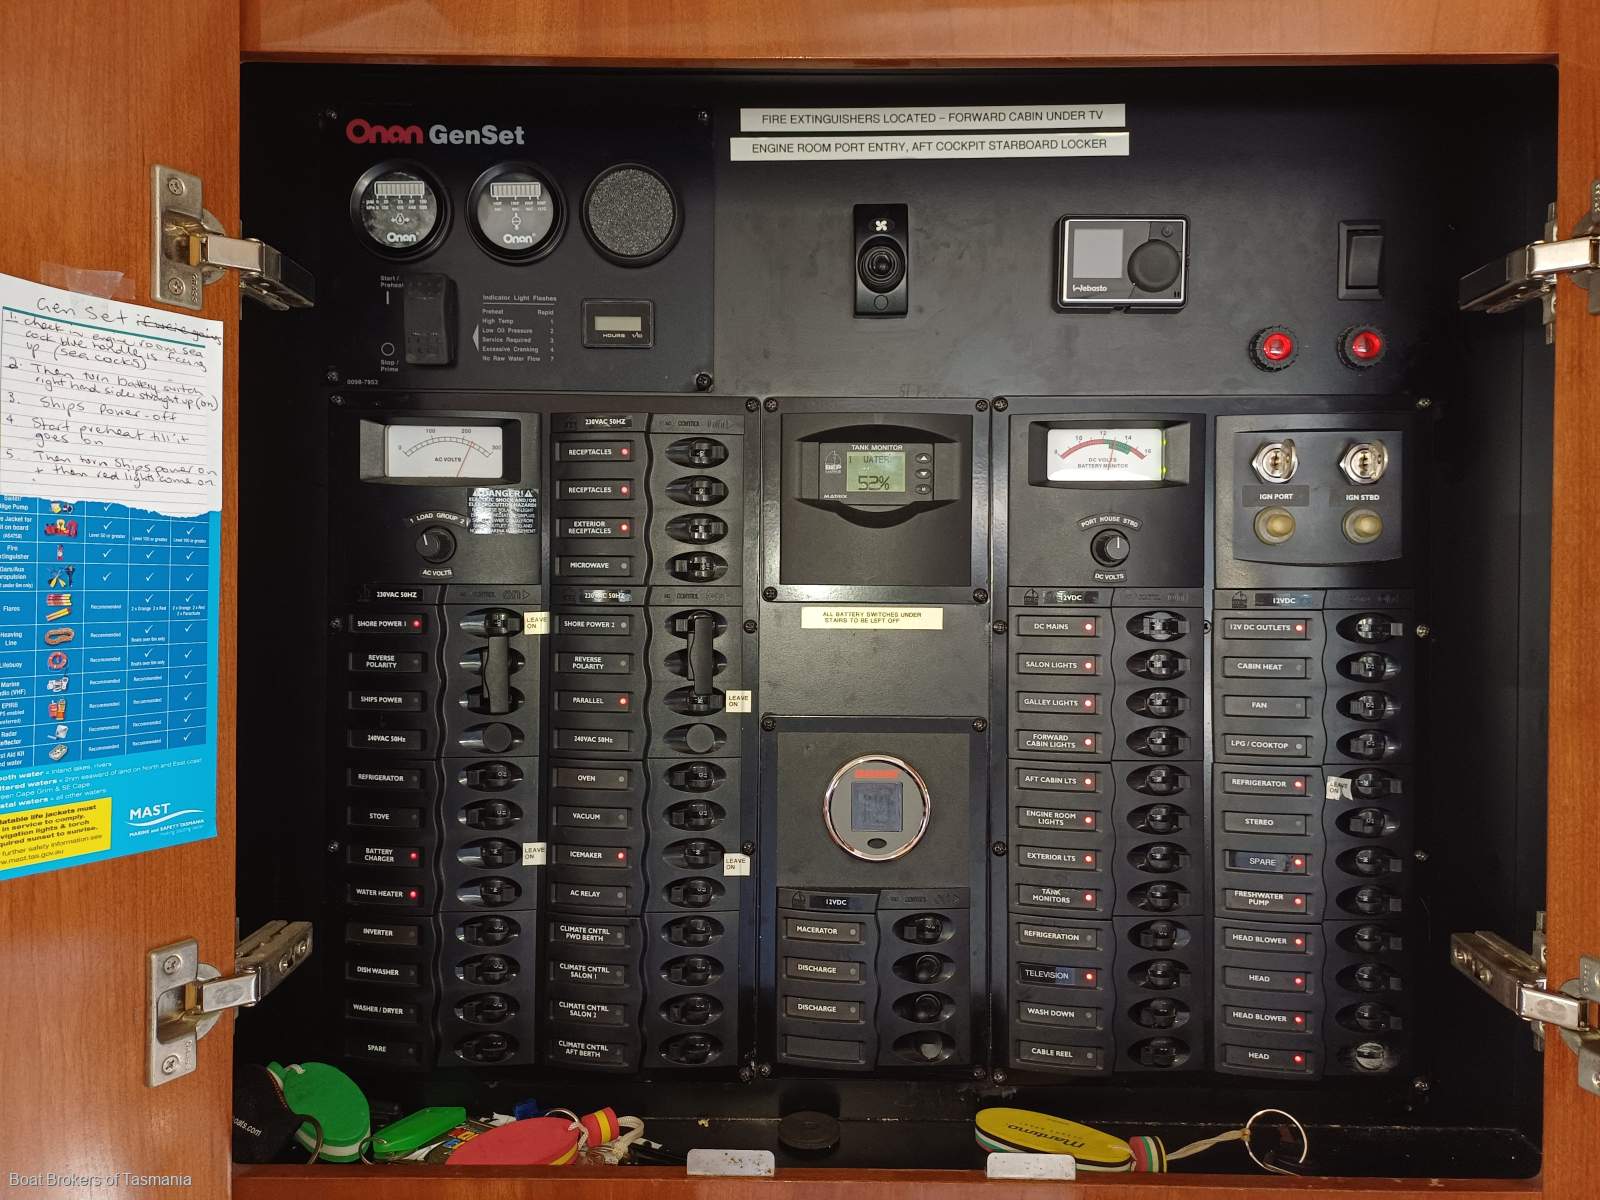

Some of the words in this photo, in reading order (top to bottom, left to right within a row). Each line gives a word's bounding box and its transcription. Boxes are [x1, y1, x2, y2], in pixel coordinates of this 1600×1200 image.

[762, 114, 787, 124] FIRE
[790, 112, 881, 124] EXTINGUISHERS
[883, 112, 936, 123] LOCATED
[948, 111, 1006, 122] FORWARD
[1008, 111, 1043, 121] CABIN
[1046, 111, 1085, 121] UNDER
[1087, 110, 1104, 120] TV
[346, 119, 423, 144] Onan
[429, 125, 525, 145] GenSet
[752, 142, 794, 154] ENGINE
[797, 142, 831, 153] ROOM
[834, 142, 866, 152] PORT
[868, 141, 909, 153] ENTRY,
[912, 141, 933, 151] AFT
[936, 140, 986, 151] COCKPIT
[989, 139, 1058, 150] STARBOARD
[1061, 138, 1107, 149] LOCKER
[387, 232, 416, 242] Onan
[503, 233, 532, 244] Onan
[1072, 284, 1107, 292] Webasto
[37, 298, 76, 315] Gen
[85, 307, 129, 324] Set
[858, 475, 890, 490] 52%
[417, 513, 433, 521] LOAD
[1081, 518, 1097, 527] PORT
[1123, 518, 1138, 528] STBD
[358, 773, 404, 782] REFRIGERATOR
[1232, 779, 1286, 788] REFRIGERATOR
[129, 803, 171, 820] MAST
[1038, 818, 1064, 826] LIGHTS
[570, 851, 602, 859] ICEMAKER
[1027, 853, 1062, 861] EXTERIOR
[1249, 858, 1276, 866] SPARE
[378, 890, 403, 898] HEATER
[1032, 895, 1070, 903] MONITORS
[1234, 891, 1284, 900] FRESHWATER
[1249, 899, 1269, 907] PUMP
[363, 928, 393, 936] INVERTER
[560, 925, 586, 934] CLIMATE
[587, 927, 610, 935] CNTRL
[796, 926, 838, 935] MACERATOR
[566, 933, 581, 941] FWD
[582, 934, 603, 942] BERTH
[1024, 930, 1079, 941] REFRIGERATION
[1232, 934, 1253, 942] HEAD
[1255, 936, 1287, 944] BLOWER
[357, 966, 371, 974] DISH
[372, 967, 399, 976] WASHER
[798, 964, 837, 974] DISCHARGE
[1025, 969, 1069, 980] TELEVISION
[353, 1004, 379, 1013] WASHER
[383, 1006, 403, 1015] DRYER
[1028, 1008, 1049, 1016] WASH
[1051, 1010, 1074, 1018] DOWN
[1031, 1048, 1054, 1056] CABLE
[1055, 1050, 1072, 1058] REEL
[1249, 1052, 1270, 1060] HEAD
